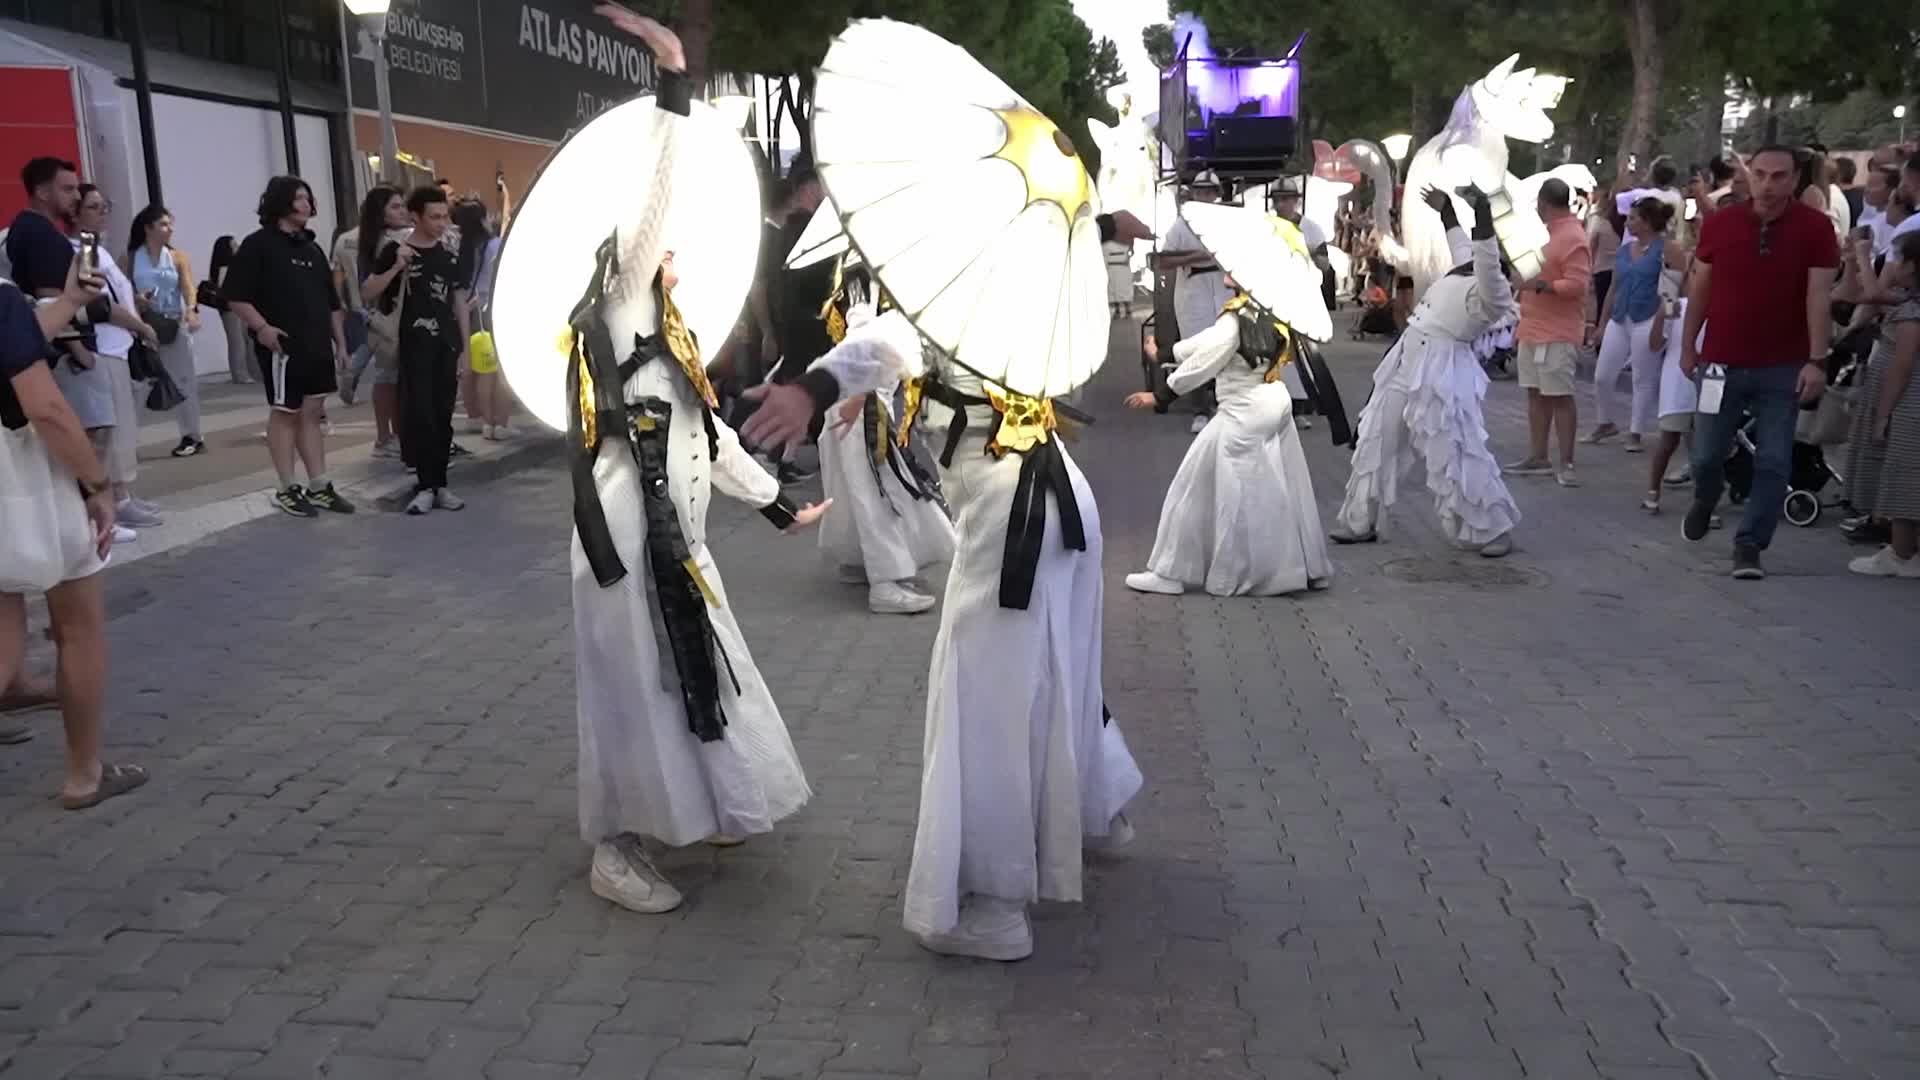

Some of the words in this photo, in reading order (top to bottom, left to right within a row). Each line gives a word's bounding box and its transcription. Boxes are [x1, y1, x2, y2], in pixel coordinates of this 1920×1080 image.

[387, 10, 464, 54] BÜYÜKŞEHİR
[520, 4, 583, 65] ATLAS
[586, 28, 653, 90] PAVYON
[390, 44, 461, 80] BELEDİYESİ
